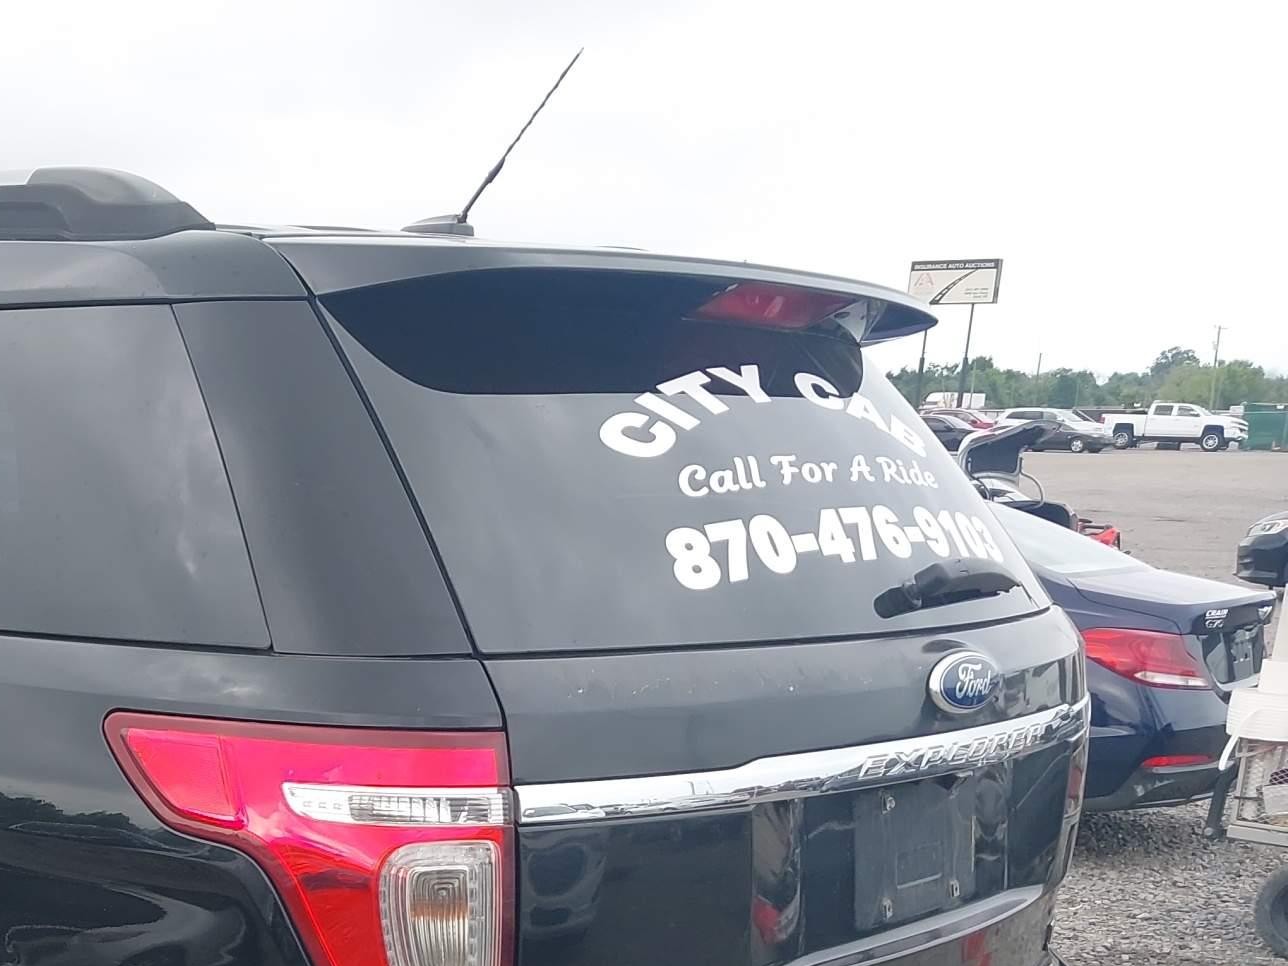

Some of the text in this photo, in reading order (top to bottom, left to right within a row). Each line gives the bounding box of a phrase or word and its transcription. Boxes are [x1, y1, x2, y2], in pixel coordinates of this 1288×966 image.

[599, 364, 927, 458] CITY CAB
[678, 453, 940, 498] Call For A Ride
[664, 504, 1004, 591] 870-476-9103
[955, 662, 993, 699] Ford
[859, 721, 1046, 780] EXPLORER
